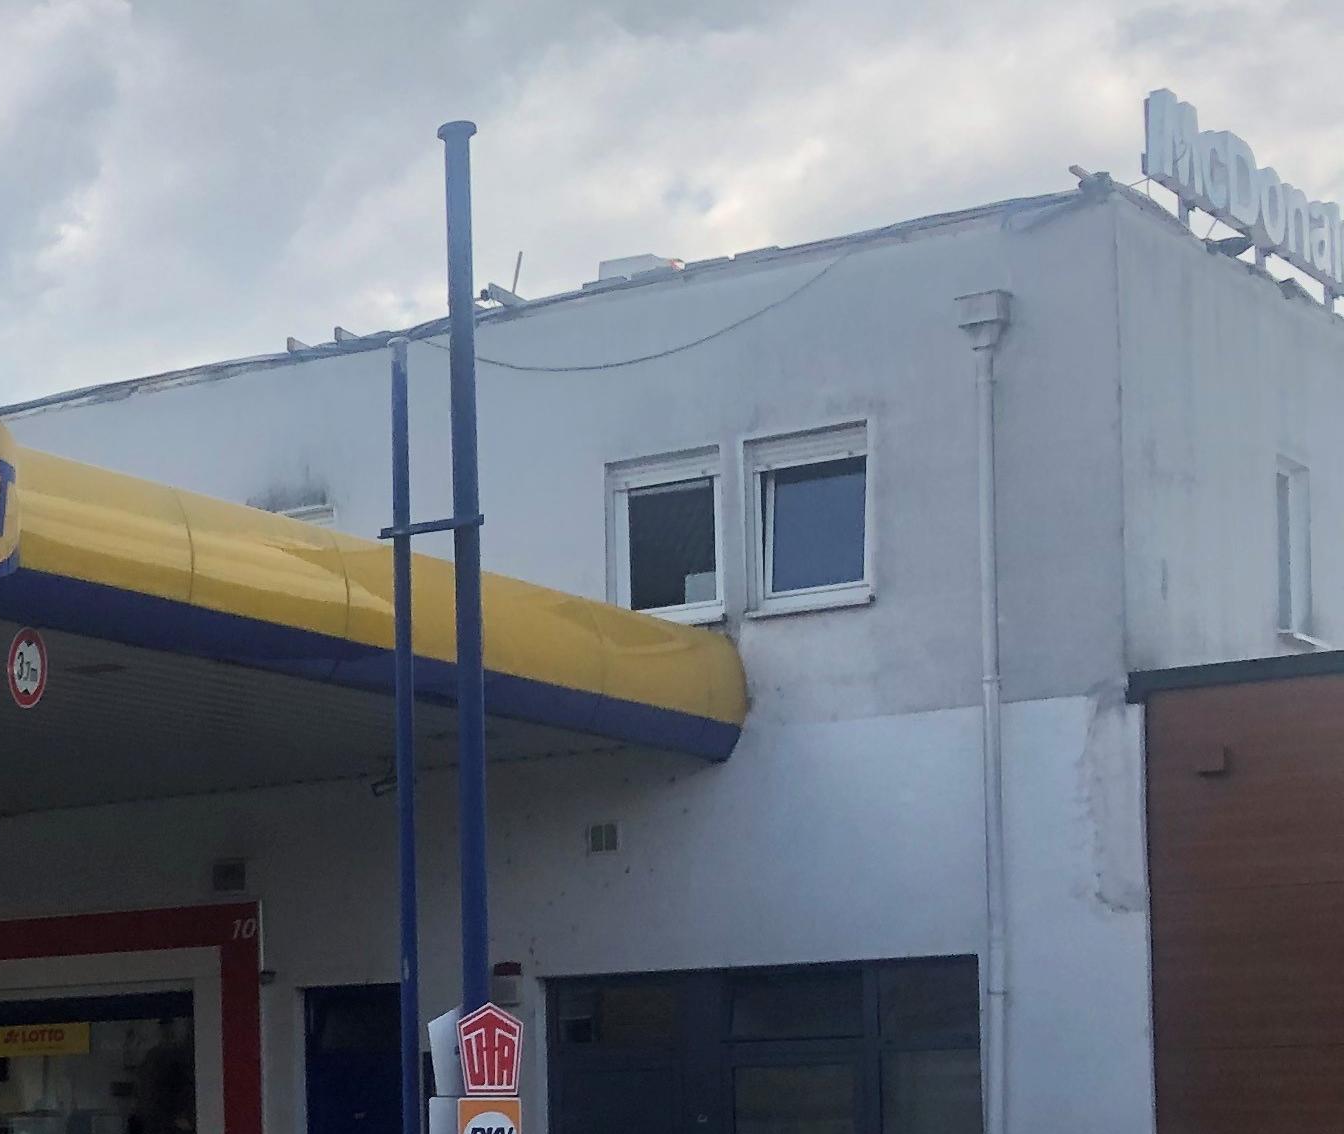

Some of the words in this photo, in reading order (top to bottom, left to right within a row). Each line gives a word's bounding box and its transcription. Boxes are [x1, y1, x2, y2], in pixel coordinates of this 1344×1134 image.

[1144, 87, 1344, 286] McDonal
[232, 918, 257, 940] 10
[21, 1029, 65, 1043] LOTTO
[462, 1010, 518, 1087] UTA
